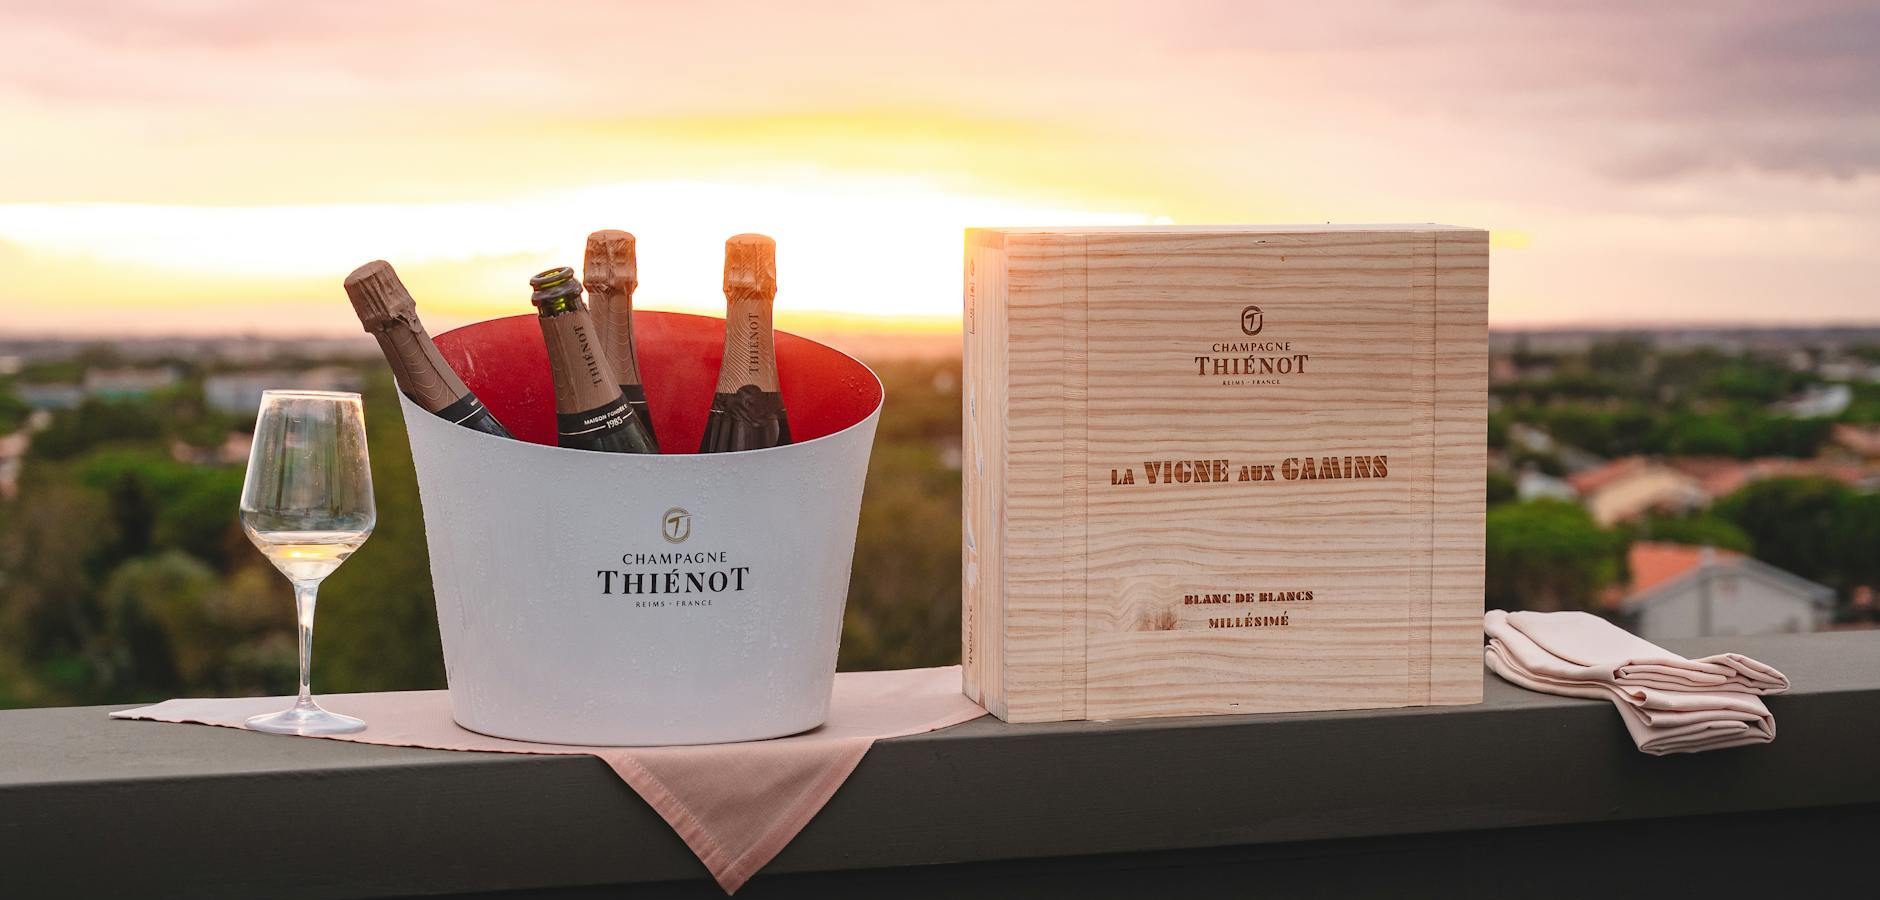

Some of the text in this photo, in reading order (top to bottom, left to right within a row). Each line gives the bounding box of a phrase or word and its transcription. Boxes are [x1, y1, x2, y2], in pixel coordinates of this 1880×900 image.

[1212, 342, 1291, 353] CHAMPAGNE
[1194, 354, 1309, 376] THIÉNOT
[583, 414, 607, 425] MAISON
[606, 416, 623, 429] 1985
[1111, 455, 1388, 486] LA VIGNE AUX GAMINS
[622, 551, 728, 565] CHAMPAGNE
[597, 566, 750, 595] THIÉNOT
[676, 599, 713, 607] FRANCE
[1184, 590, 1314, 606] BLANC DE BLANCS
[1208, 611, 1289, 629] MILLÉSIMÉ
